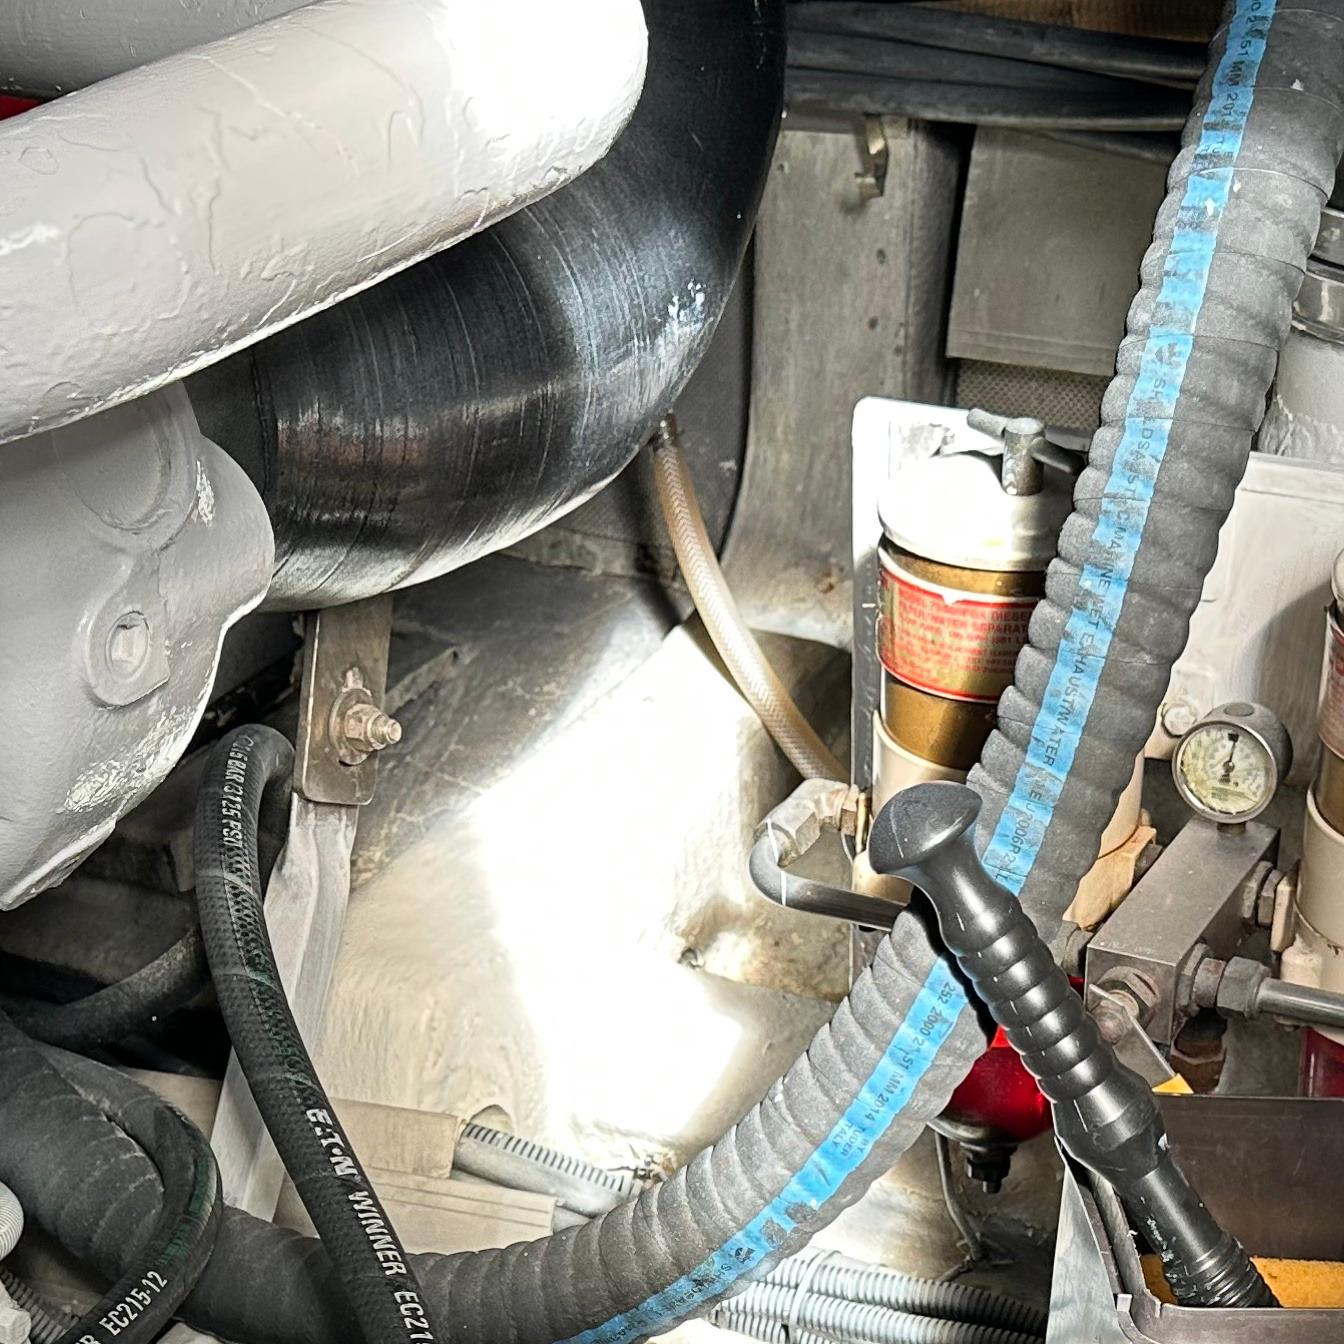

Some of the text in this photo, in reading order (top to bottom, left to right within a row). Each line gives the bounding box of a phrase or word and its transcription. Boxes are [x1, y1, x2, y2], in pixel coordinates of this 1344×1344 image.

[1219, 90, 1238, 124] 201
[348, 1190, 408, 1277] WINNER
[99, 1270, 170, 1337] EC215-12
